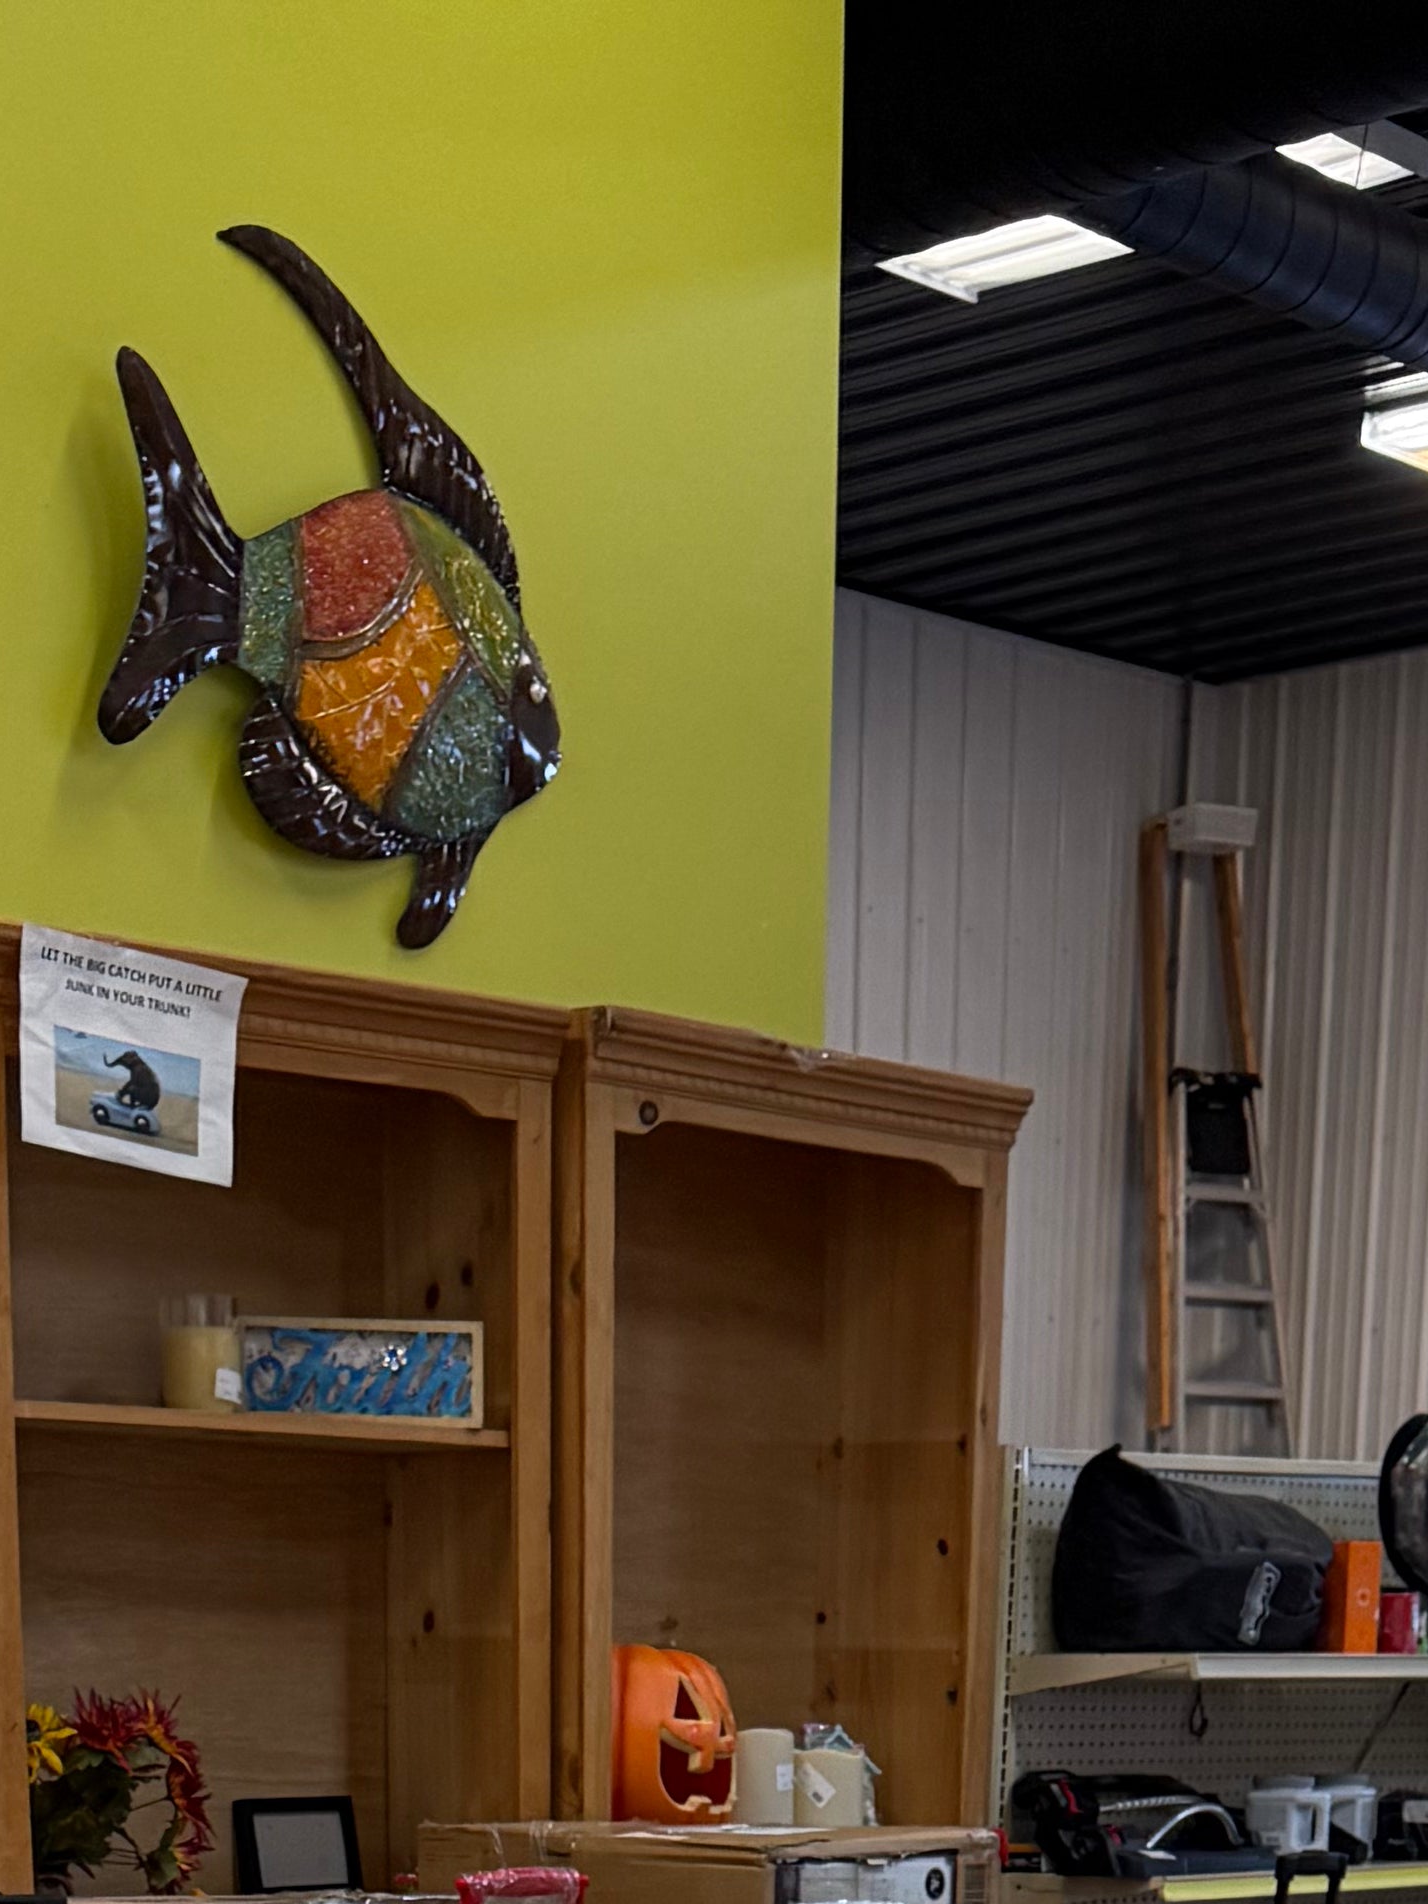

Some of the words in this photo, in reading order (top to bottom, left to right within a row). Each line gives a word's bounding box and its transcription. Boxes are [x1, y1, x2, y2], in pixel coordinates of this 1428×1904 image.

[41, 946, 59, 962] LET
[63, 952, 83, 969] THE
[86, 958, 106, 975] BIG
[108, 964, 146, 984] CATCH
[150, 973, 172, 990] PUT
[174, 981, 185, 992] A
[186, 982, 223, 1002] LITTLE
[65, 979, 94, 997] JUNK
[97, 985, 110, 1000] IN
[113, 990, 144, 1008] YOUR
[147, 997, 191, 1019] TRUNK!
